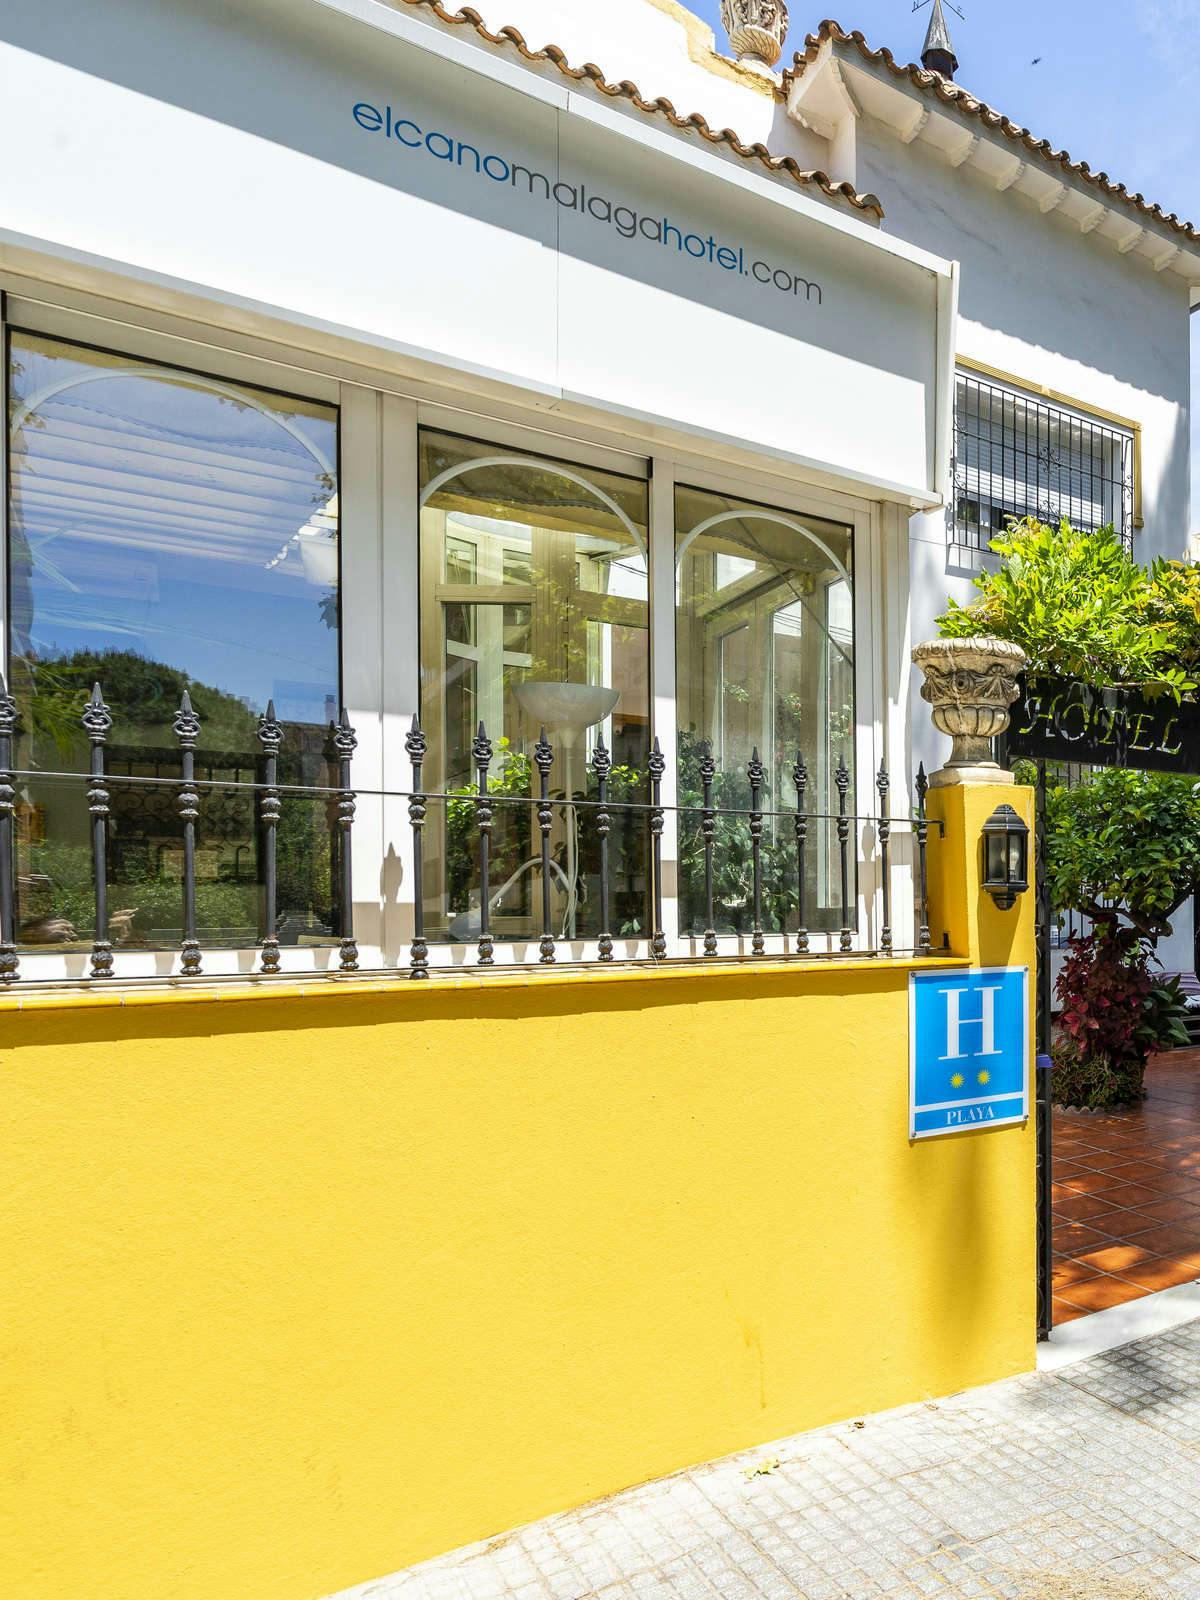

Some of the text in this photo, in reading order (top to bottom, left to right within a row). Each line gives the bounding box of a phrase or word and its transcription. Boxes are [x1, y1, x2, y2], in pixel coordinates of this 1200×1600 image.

[352, 102, 823, 304] elcanomalagahotel.com
[1018, 694, 1183, 756] HOTEL
[938, 986, 1003, 1060] H
[945, 1104, 995, 1125] PLAYA
